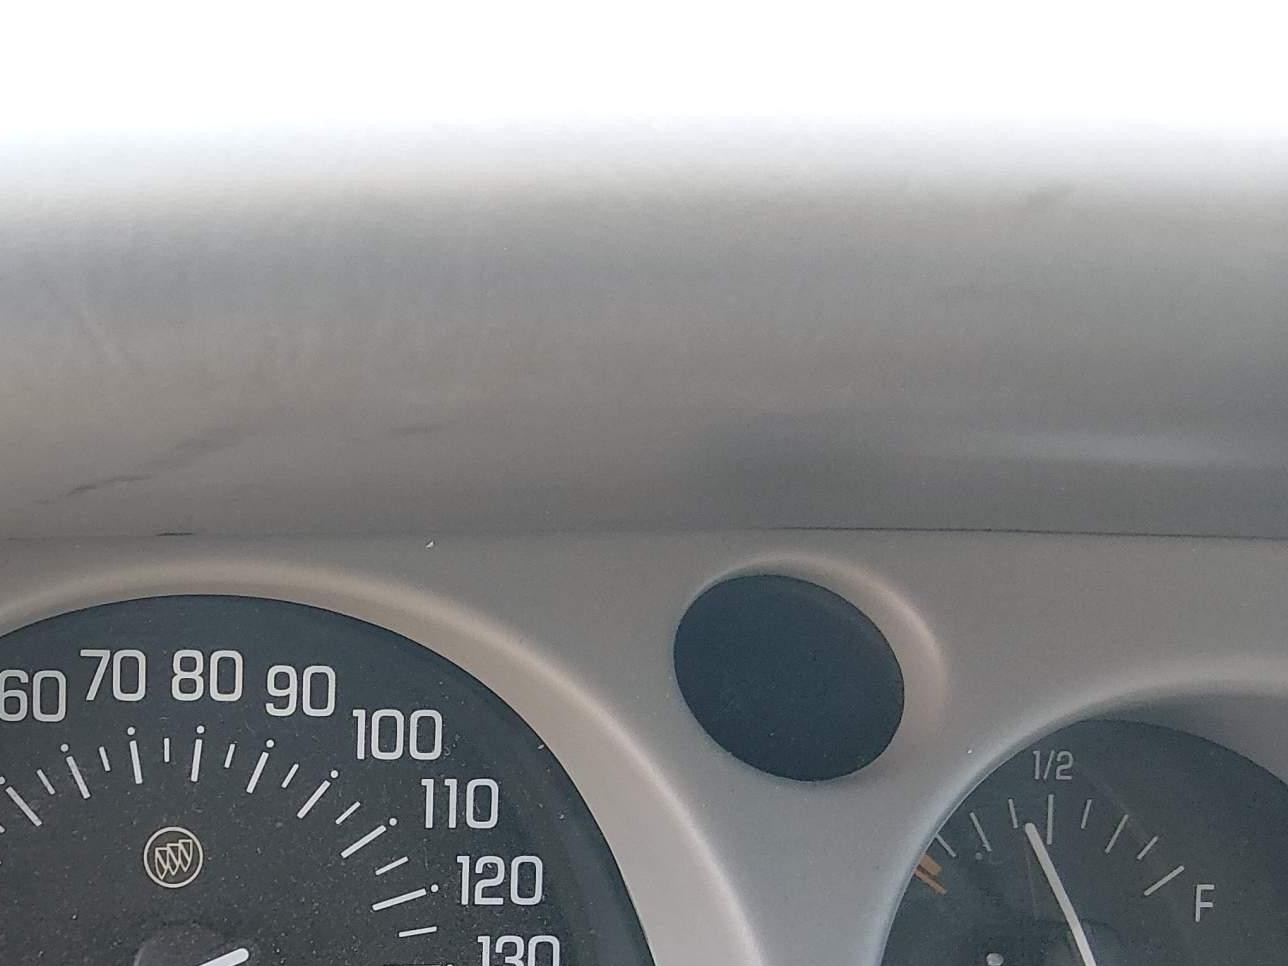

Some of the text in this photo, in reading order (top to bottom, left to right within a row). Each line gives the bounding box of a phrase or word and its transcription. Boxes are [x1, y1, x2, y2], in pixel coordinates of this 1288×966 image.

[80, 650, 147, 702] 70
[171, 650, 243, 702] 80
[265, 665, 337, 718] 90
[353, 708, 444, 761] 100
[1031, 750, 1074, 781] 1/2
[421, 778, 499, 830] 110
[456, 855, 543, 907] 120
[1195, 884, 1215, 922] F
